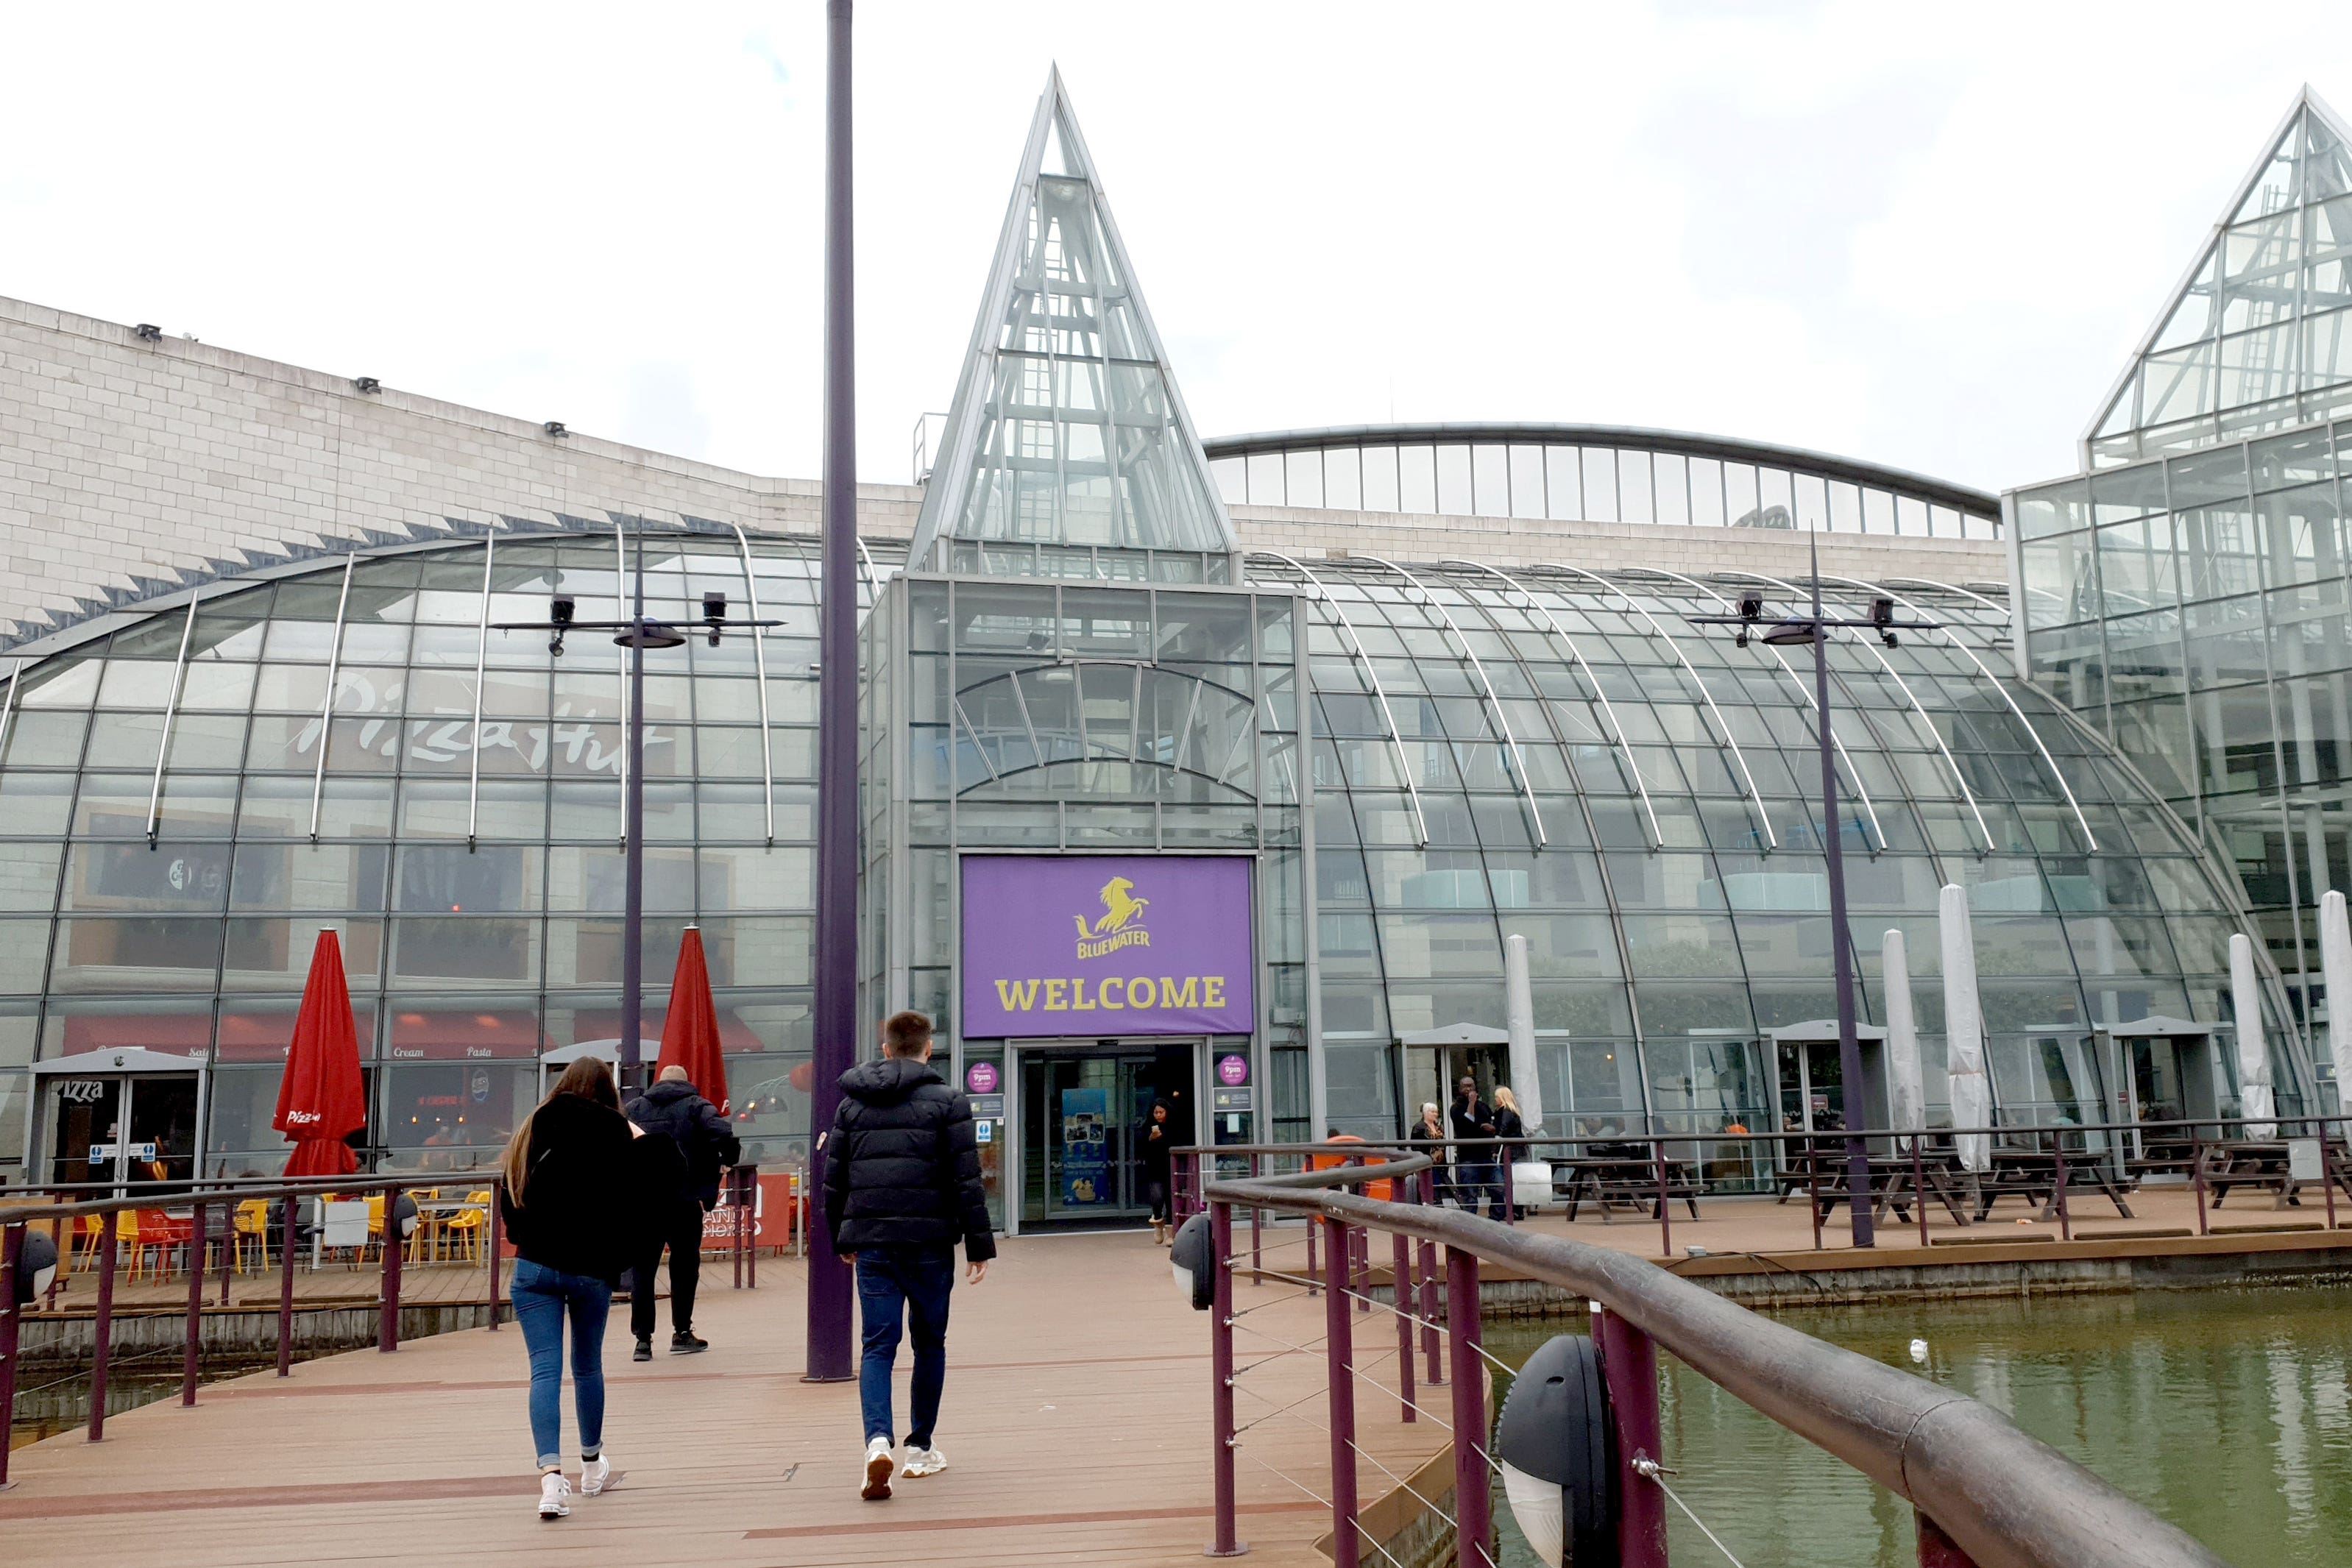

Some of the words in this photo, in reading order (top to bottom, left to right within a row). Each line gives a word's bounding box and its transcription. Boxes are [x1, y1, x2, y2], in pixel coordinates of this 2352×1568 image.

[297, 670, 518, 764] Pizza
[994, 976, 1226, 1012] WELCOME
[393, 1047, 425, 1057] Cream
[466, 1046, 492, 1057] Pasta
[1224, 1065, 1241, 1074] 9pm
[973, 1074, 991, 1082] 9pm
